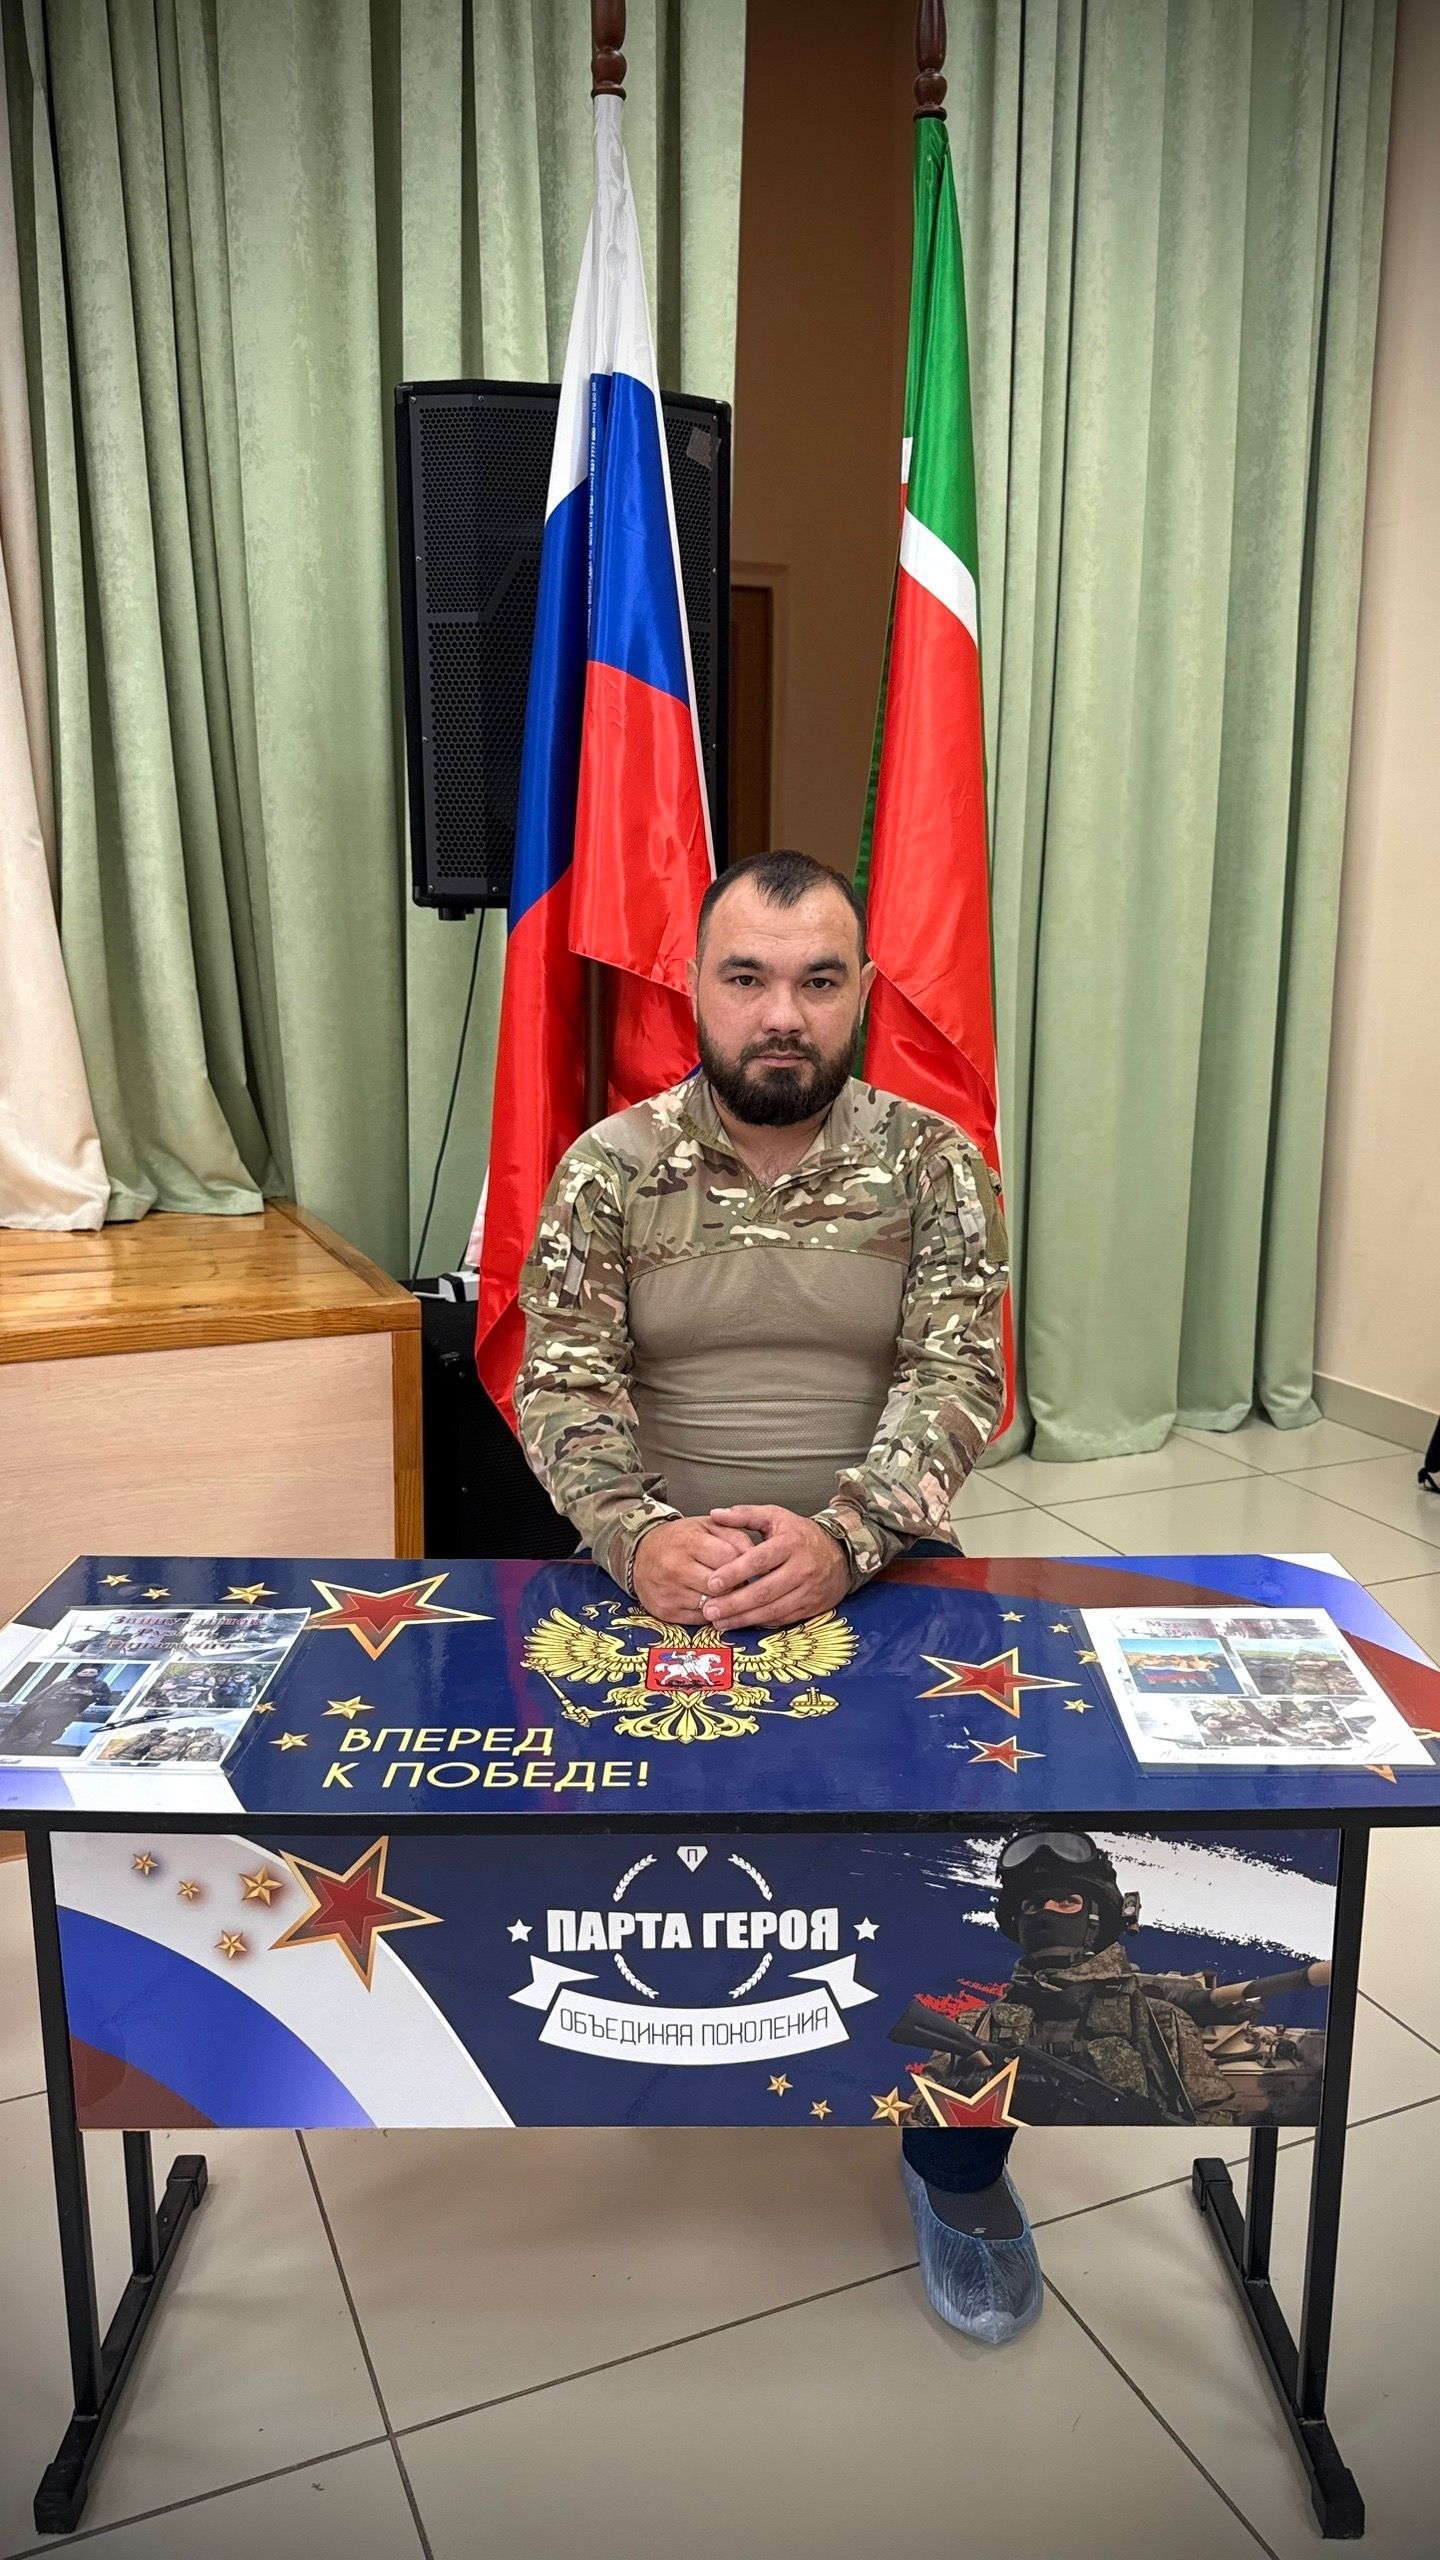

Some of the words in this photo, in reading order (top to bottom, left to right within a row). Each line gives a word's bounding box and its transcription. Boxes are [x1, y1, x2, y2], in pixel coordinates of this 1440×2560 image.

[339, 1728, 554, 1756] ВПЕРЕД
[322, 1762, 360, 1788] К
[382, 1761, 648, 1792] ПОБЕДЕ!
[547, 1909, 692, 1952] ПАРТА
[703, 1907, 839, 1951] ГЕРОЯ
[560, 2008, 693, 2047] ОБЪЕДИНЯЯ
[701, 2006, 829, 2047] ПОКОЛЕНИЯ
